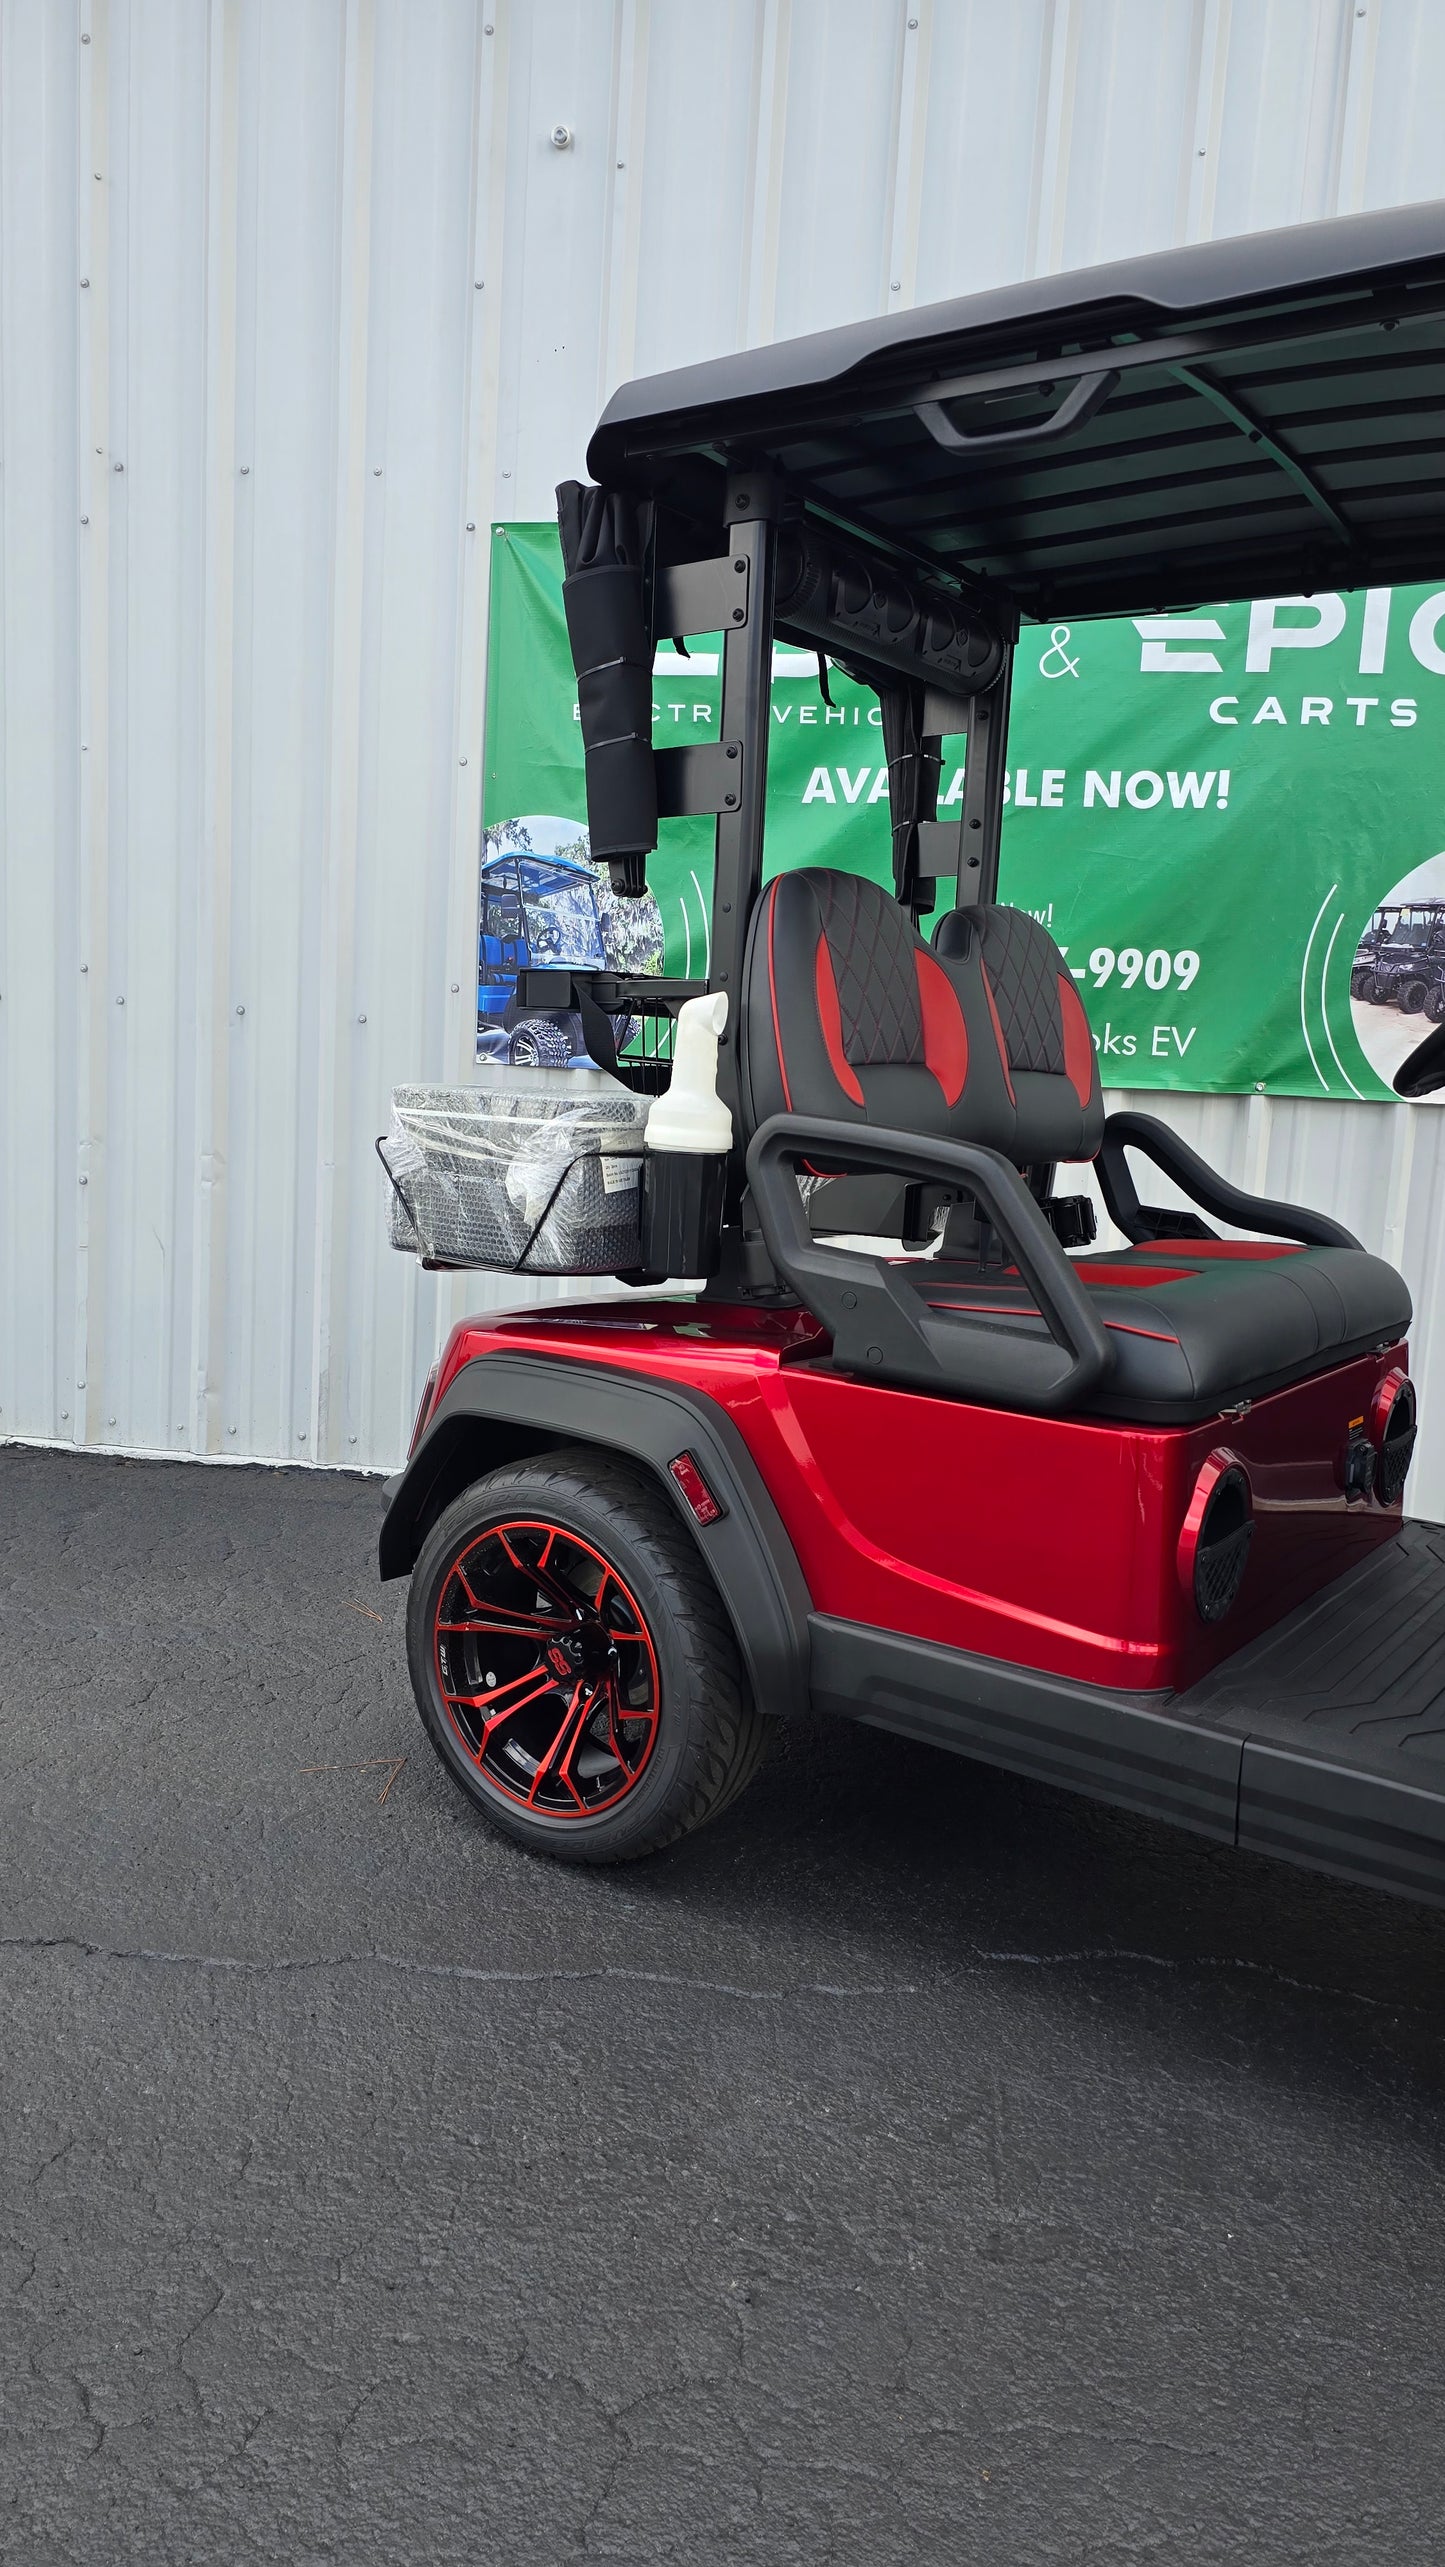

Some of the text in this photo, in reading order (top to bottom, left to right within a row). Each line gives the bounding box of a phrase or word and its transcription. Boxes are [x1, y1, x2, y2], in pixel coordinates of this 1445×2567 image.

[1039, 625, 1081, 679] &
[771, 704, 884, 727] VEHIC
[1208, 696, 1418, 727] CARTS
[1083, 770, 1231, 810] NOW!
[1057, 946, 1200, 991] -9909
[1151, 1026, 1197, 1058] EV
[439, 1645, 449, 1677] GTW
